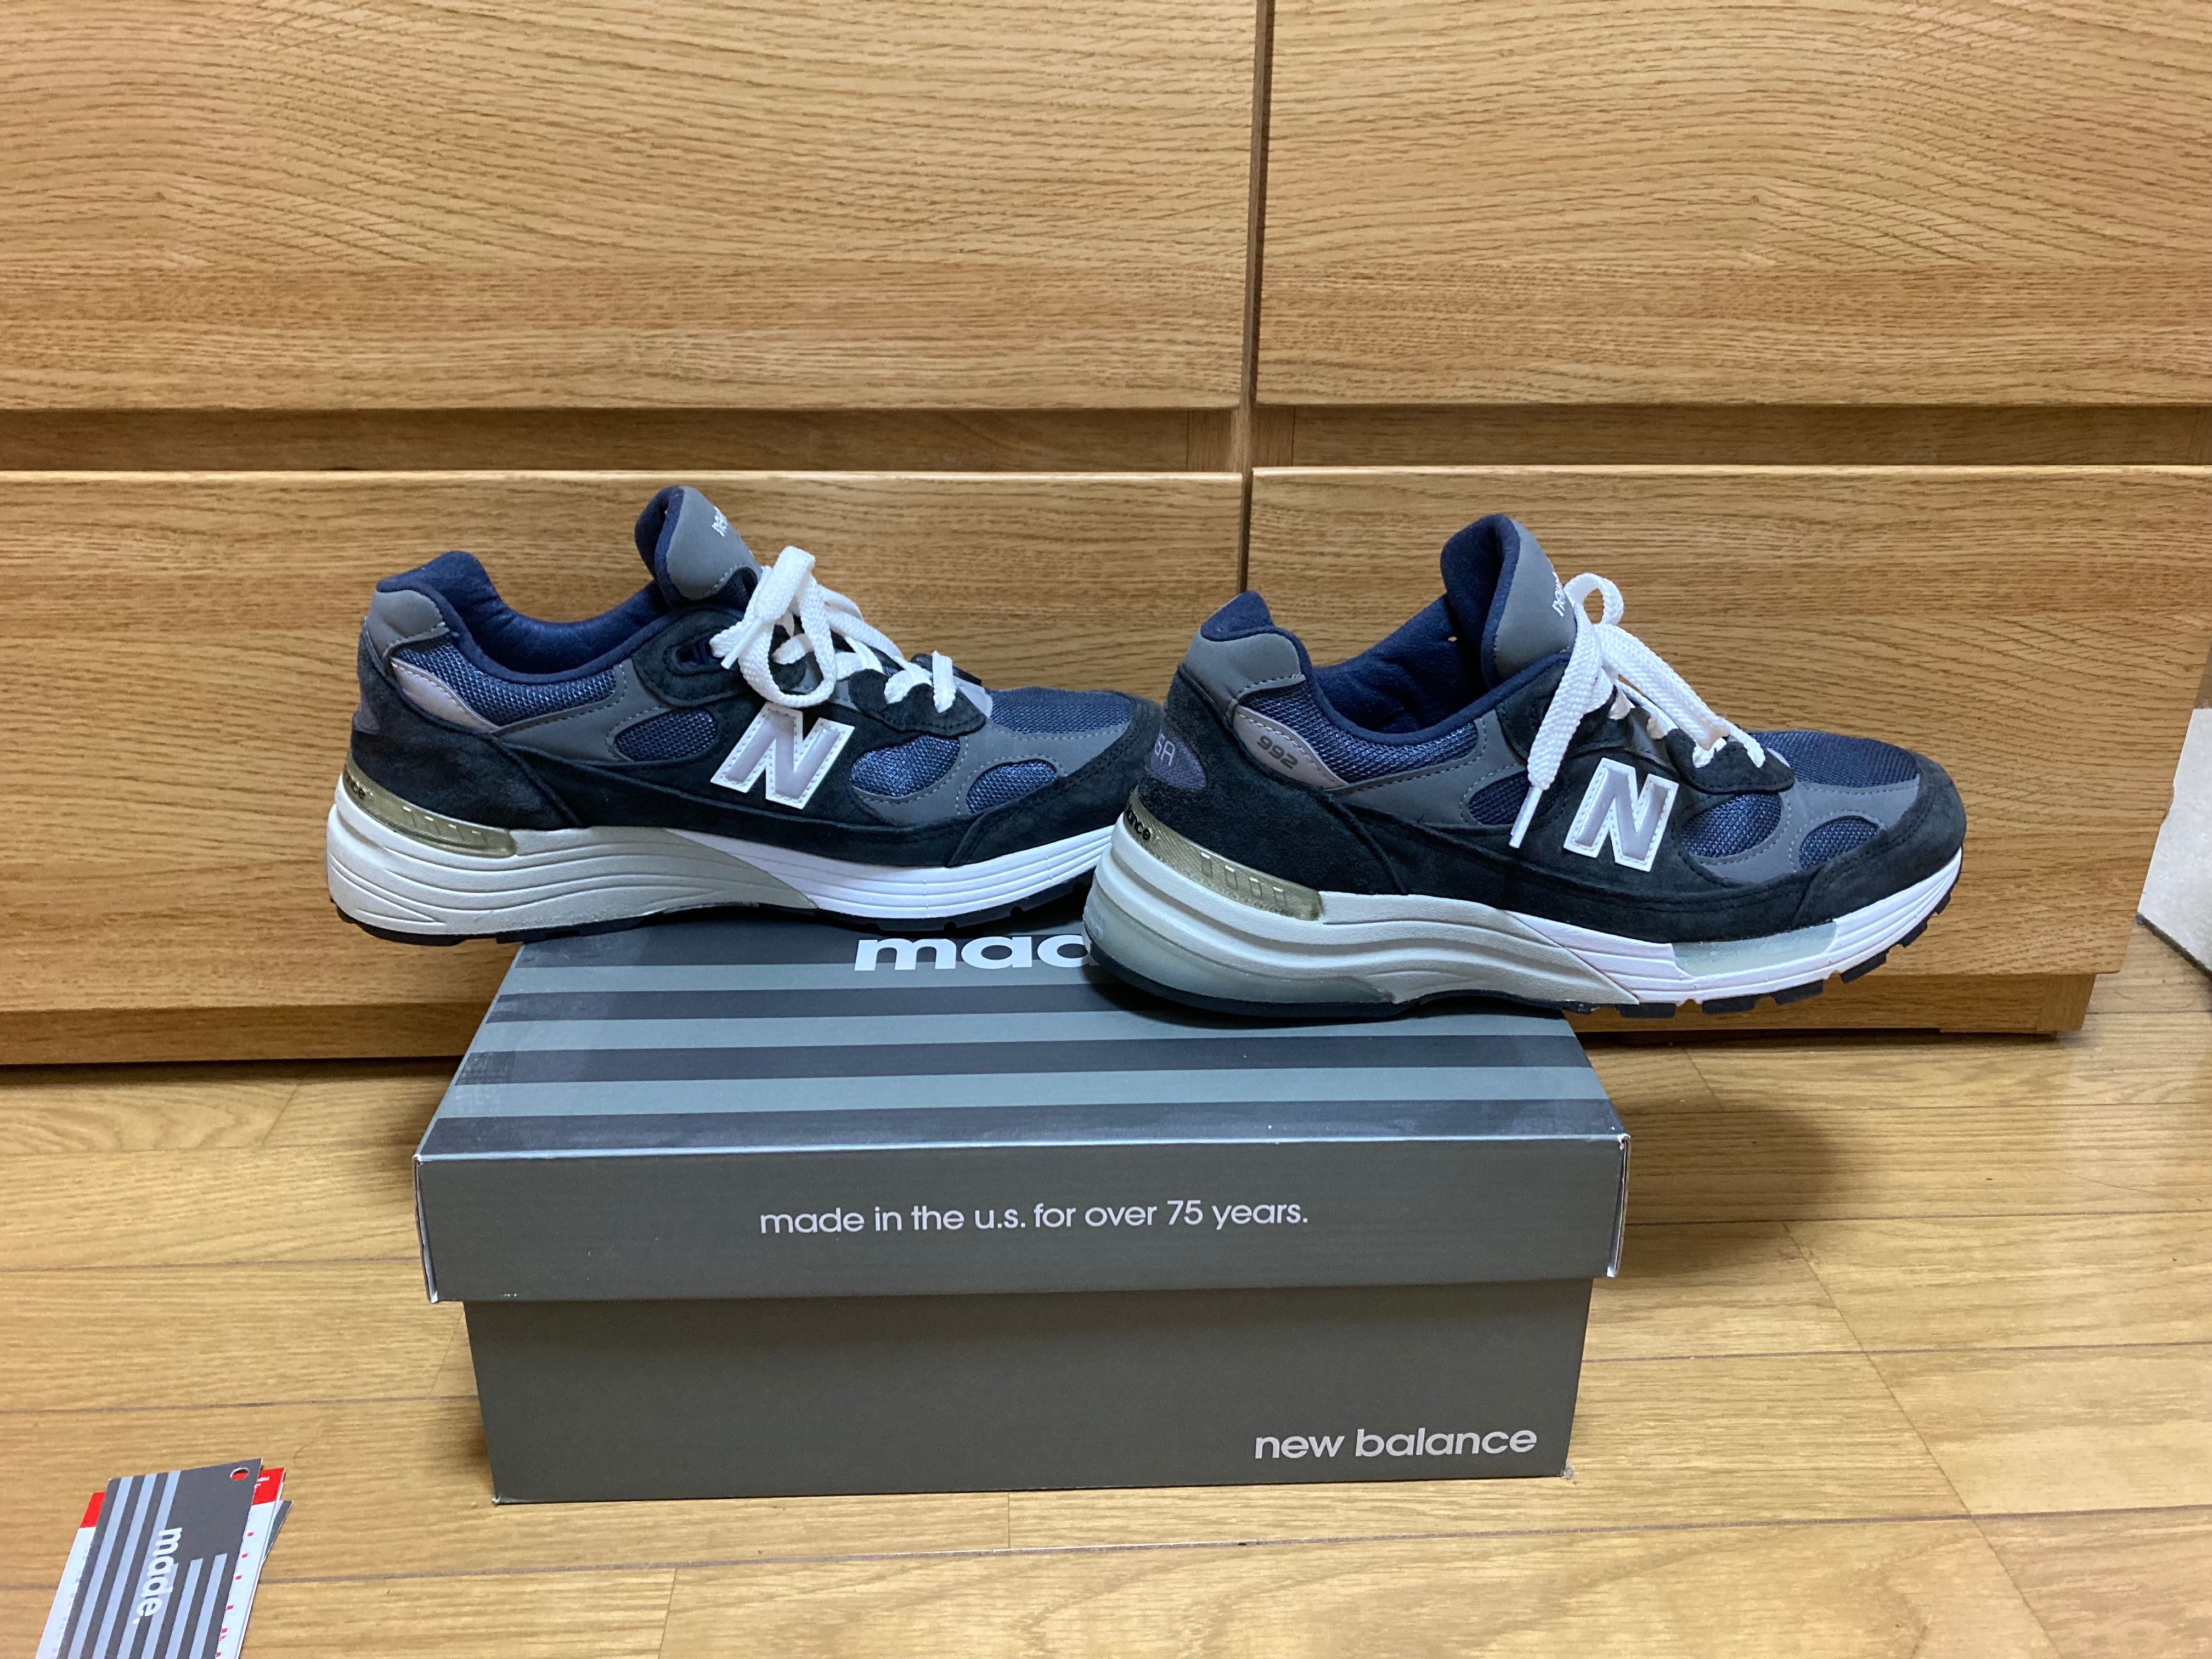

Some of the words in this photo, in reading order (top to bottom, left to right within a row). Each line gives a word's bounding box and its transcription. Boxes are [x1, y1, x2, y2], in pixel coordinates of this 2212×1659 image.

[710, 702, 855, 809] N
[1256, 735, 1299, 769] 992
[1564, 758, 1679, 872] N
[760, 1207, 865, 1234] made
[874, 1206, 902, 1231] in
[911, 1205, 964, 1231] the
[974, 1207, 1026, 1229] u.s.
[1033, 1203, 1076, 1228] for
[1084, 1206, 1158, 1227] over
[1167, 1199, 1204, 1226] 75
[1211, 1203, 1308, 1230] years.
[1255, 1435, 1345, 1459] new
[1355, 1427, 1538, 1457] balance
